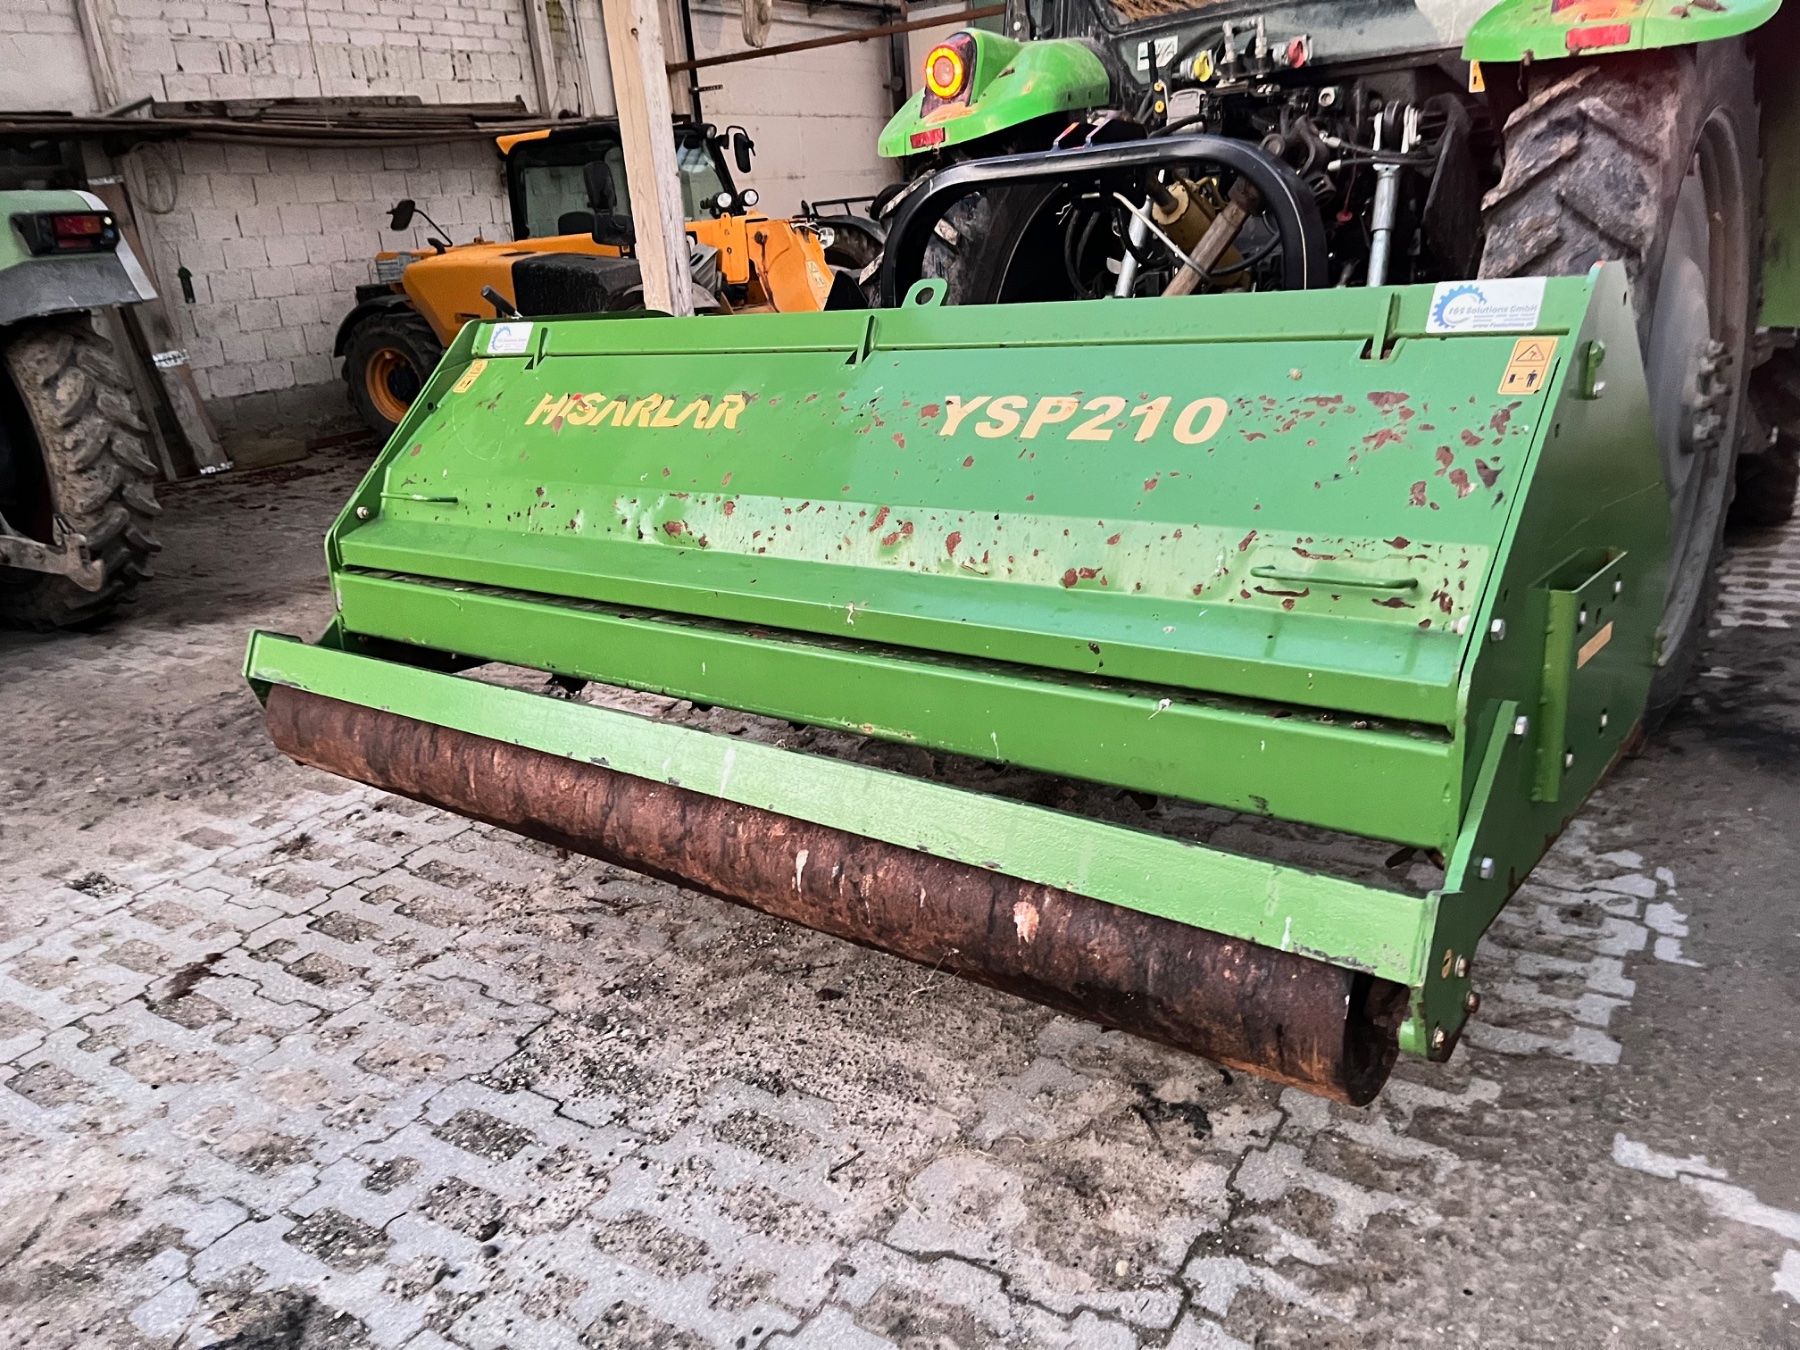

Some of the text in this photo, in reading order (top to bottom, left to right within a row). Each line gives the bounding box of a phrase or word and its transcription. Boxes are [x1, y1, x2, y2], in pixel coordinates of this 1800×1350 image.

[1466, 305, 1508, 314] Solutions
[1510, 304, 1538, 313] GmbH
[524, 392, 1229, 445] HISARLAR YSP210
